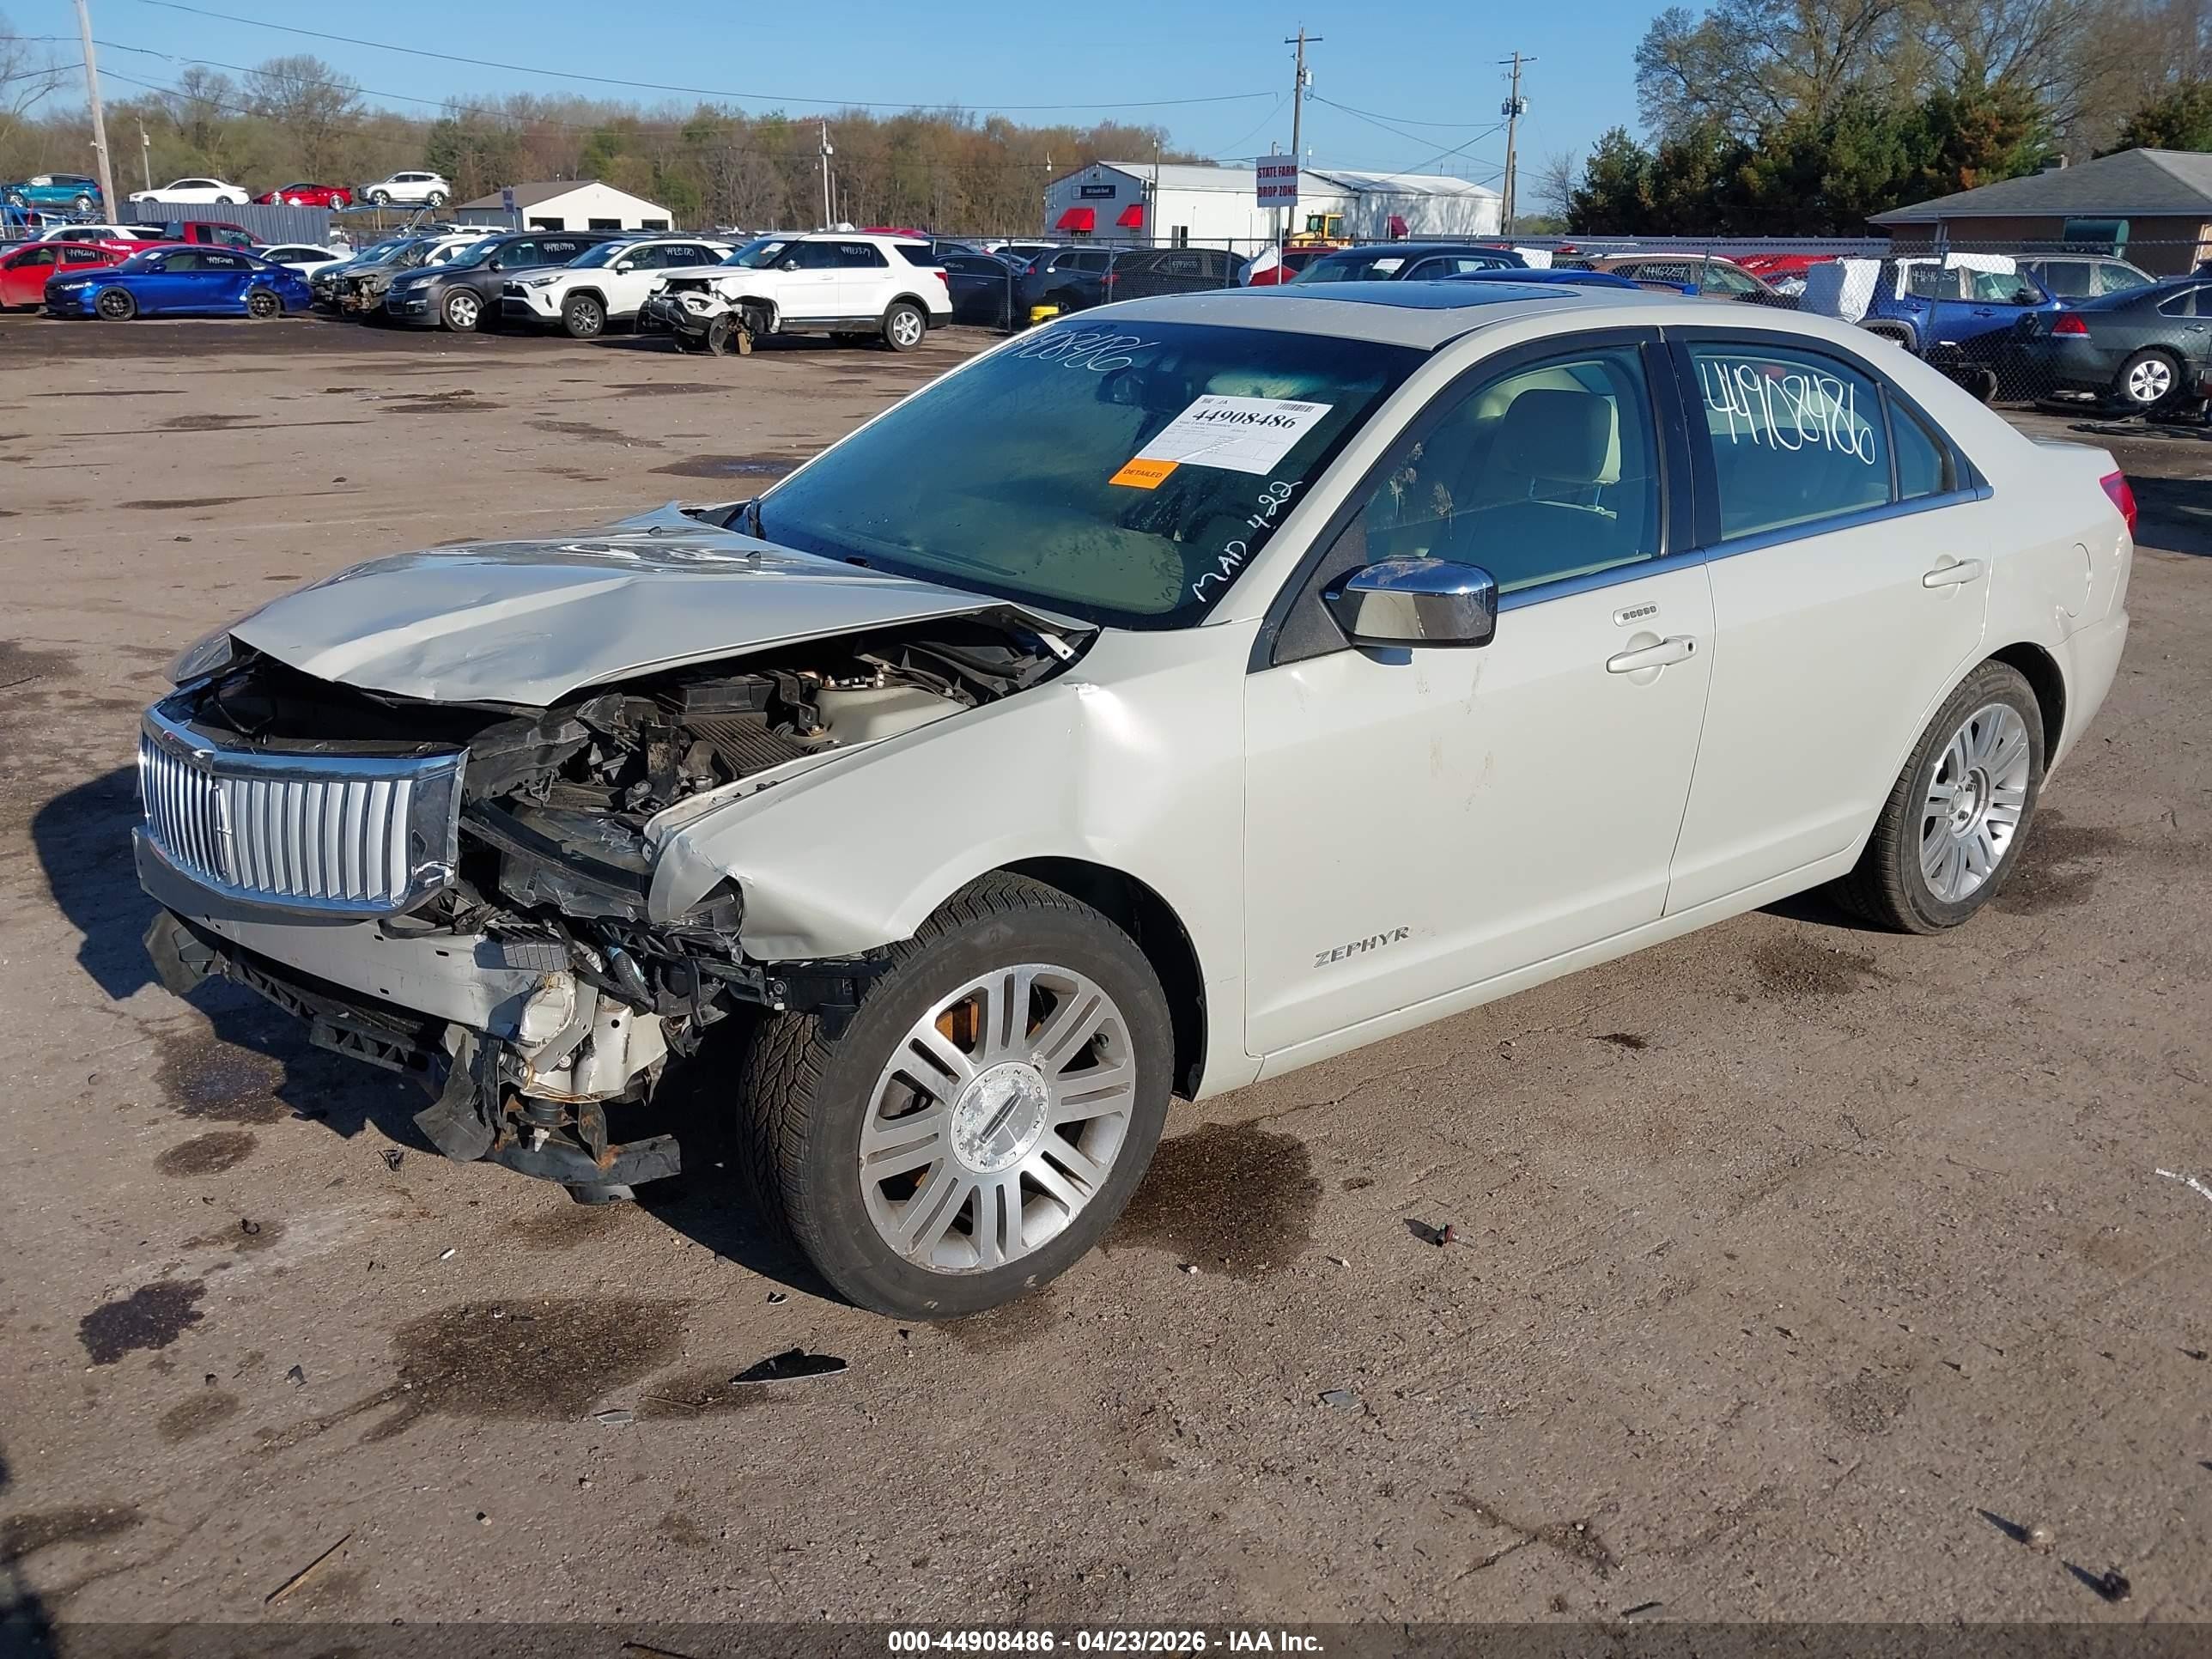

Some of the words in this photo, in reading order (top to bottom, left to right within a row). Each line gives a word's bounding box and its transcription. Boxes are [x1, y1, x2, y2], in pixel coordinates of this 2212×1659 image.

[1257, 167, 1277, 179] STATE
[1279, 165, 1297, 177] FARM
[1258, 186, 1278, 198] DROP
[1279, 185, 1297, 197] ZONE
[1193, 409, 1303, 429] 44908486
[1701, 362, 1875, 465] 44908486
[1123, 469, 1163, 478] DETAILED
[1313, 926, 1409, 969] ZEPHYR
